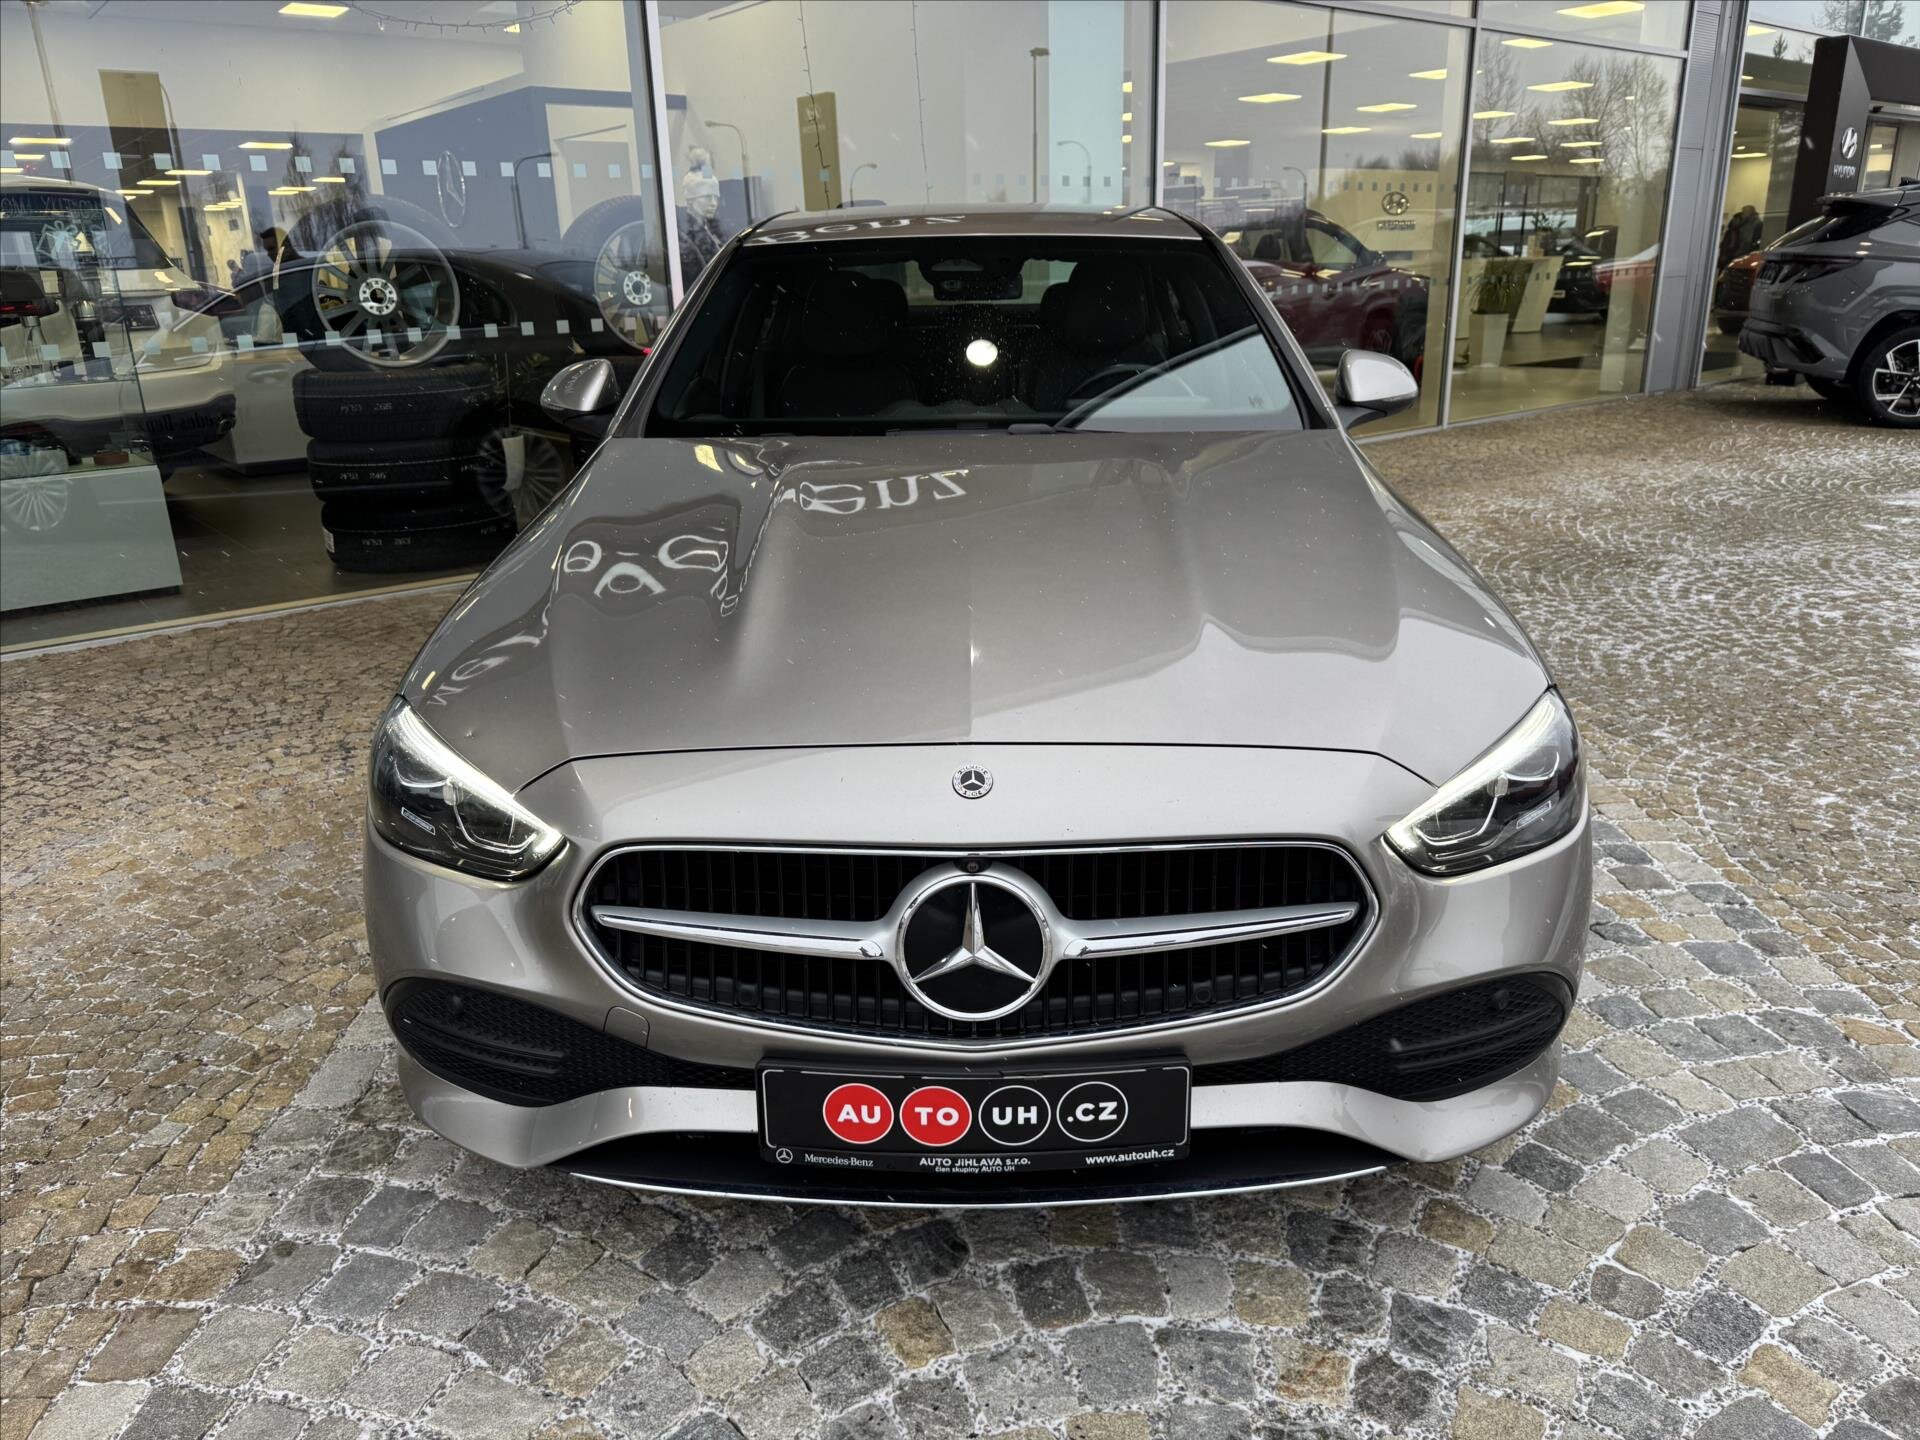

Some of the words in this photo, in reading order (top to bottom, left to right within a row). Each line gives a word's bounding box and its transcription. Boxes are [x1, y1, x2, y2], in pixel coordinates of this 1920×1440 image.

[992, 1106, 1038, 1126] UH
[1067, 1101, 1118, 1122] .CZ
[804, 1153, 874, 1167] Mercedes-Benz
[920, 1157, 951, 1167] AUTO
[954, 1157, 1002, 1167] JIHLAVA
[1005, 1157, 1031, 1166] s.r.o.
[1086, 1148, 1174, 1165] www.autouh.cz
[935, 1166, 950, 1174] člen
[951, 1167, 979, 1175] skupiny
